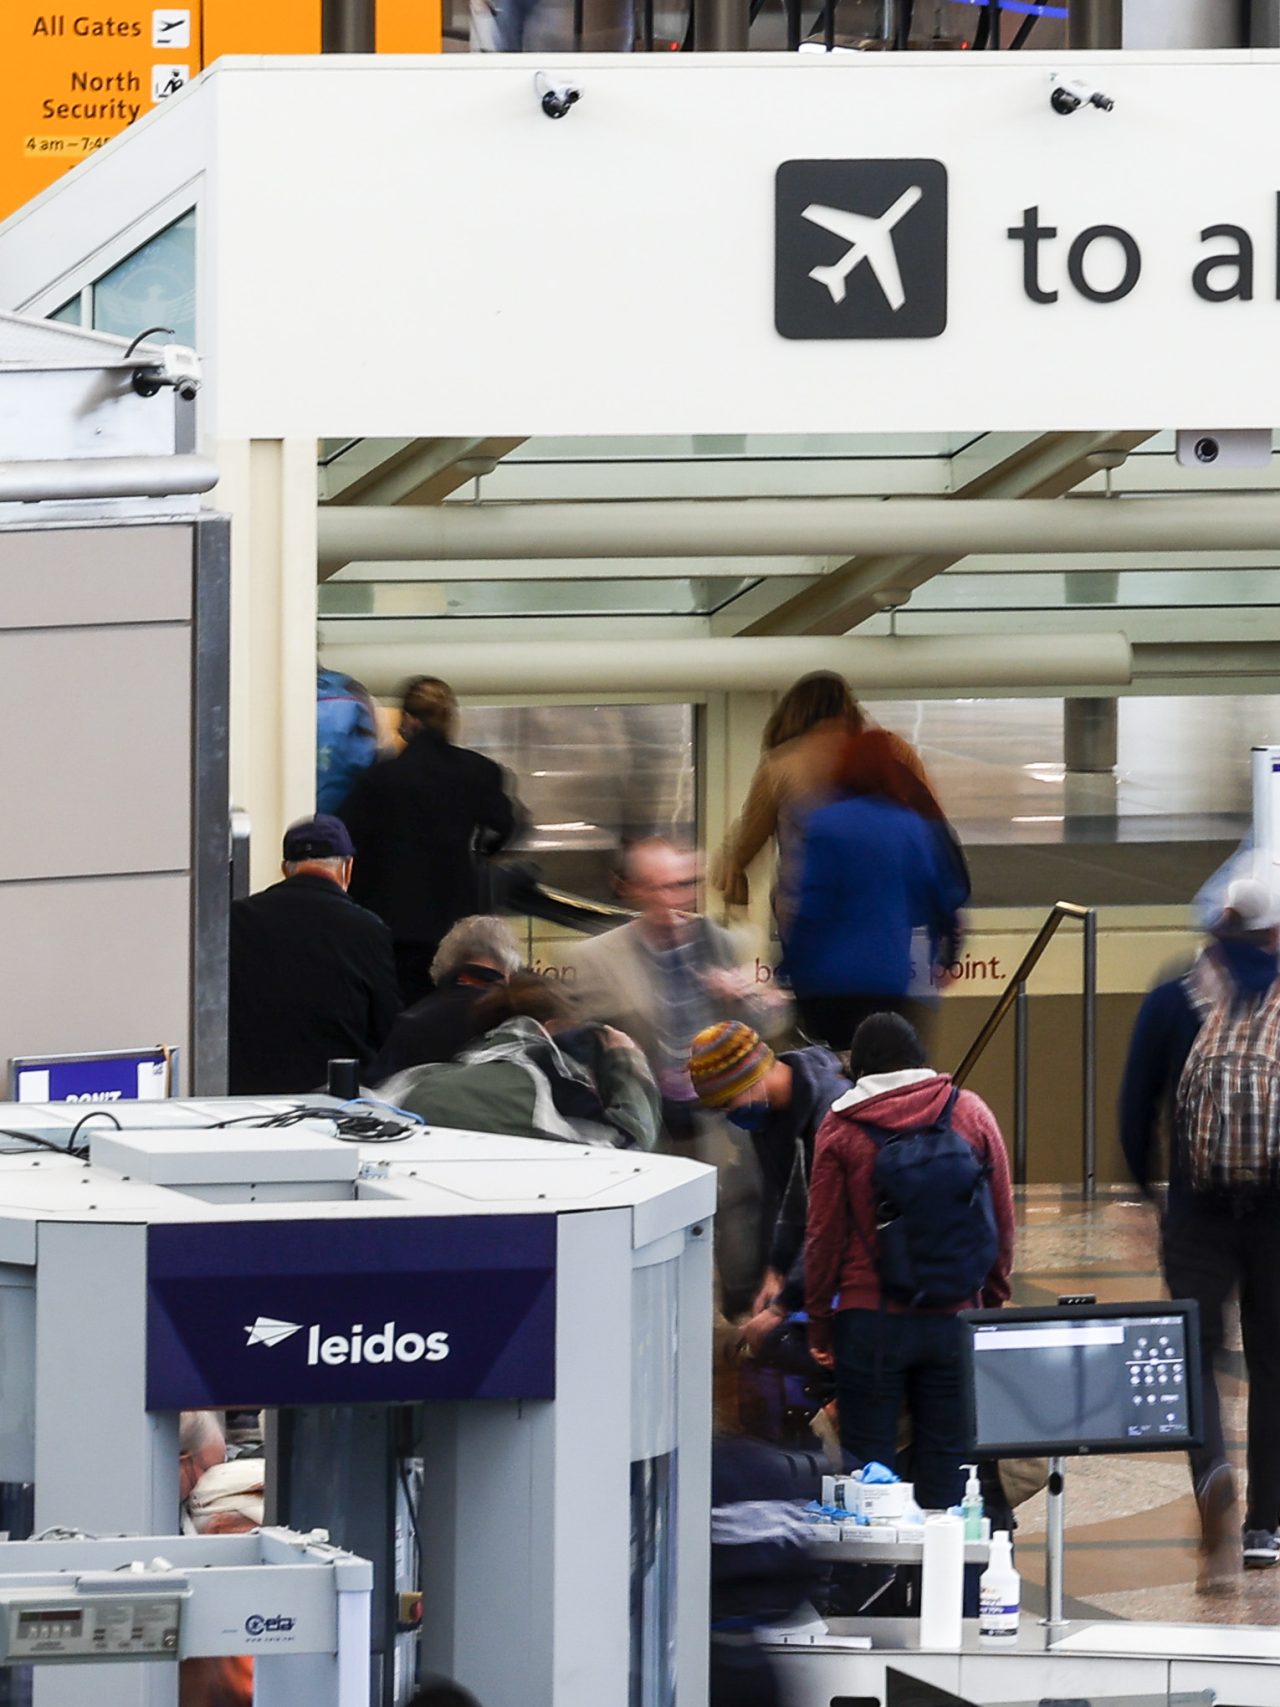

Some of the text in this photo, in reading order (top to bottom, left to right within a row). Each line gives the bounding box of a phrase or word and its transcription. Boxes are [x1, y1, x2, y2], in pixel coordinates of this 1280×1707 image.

[33, 15, 142, 37] All Gates
[71, 71, 141, 92] North
[42, 98, 141, 125] Security
[26, 137, 37, 151] 4
[40, 140, 64, 151] am
[1007, 205, 1142, 305] to
[929, 953, 1007, 986] point.
[307, 1321, 450, 1366] leidos
